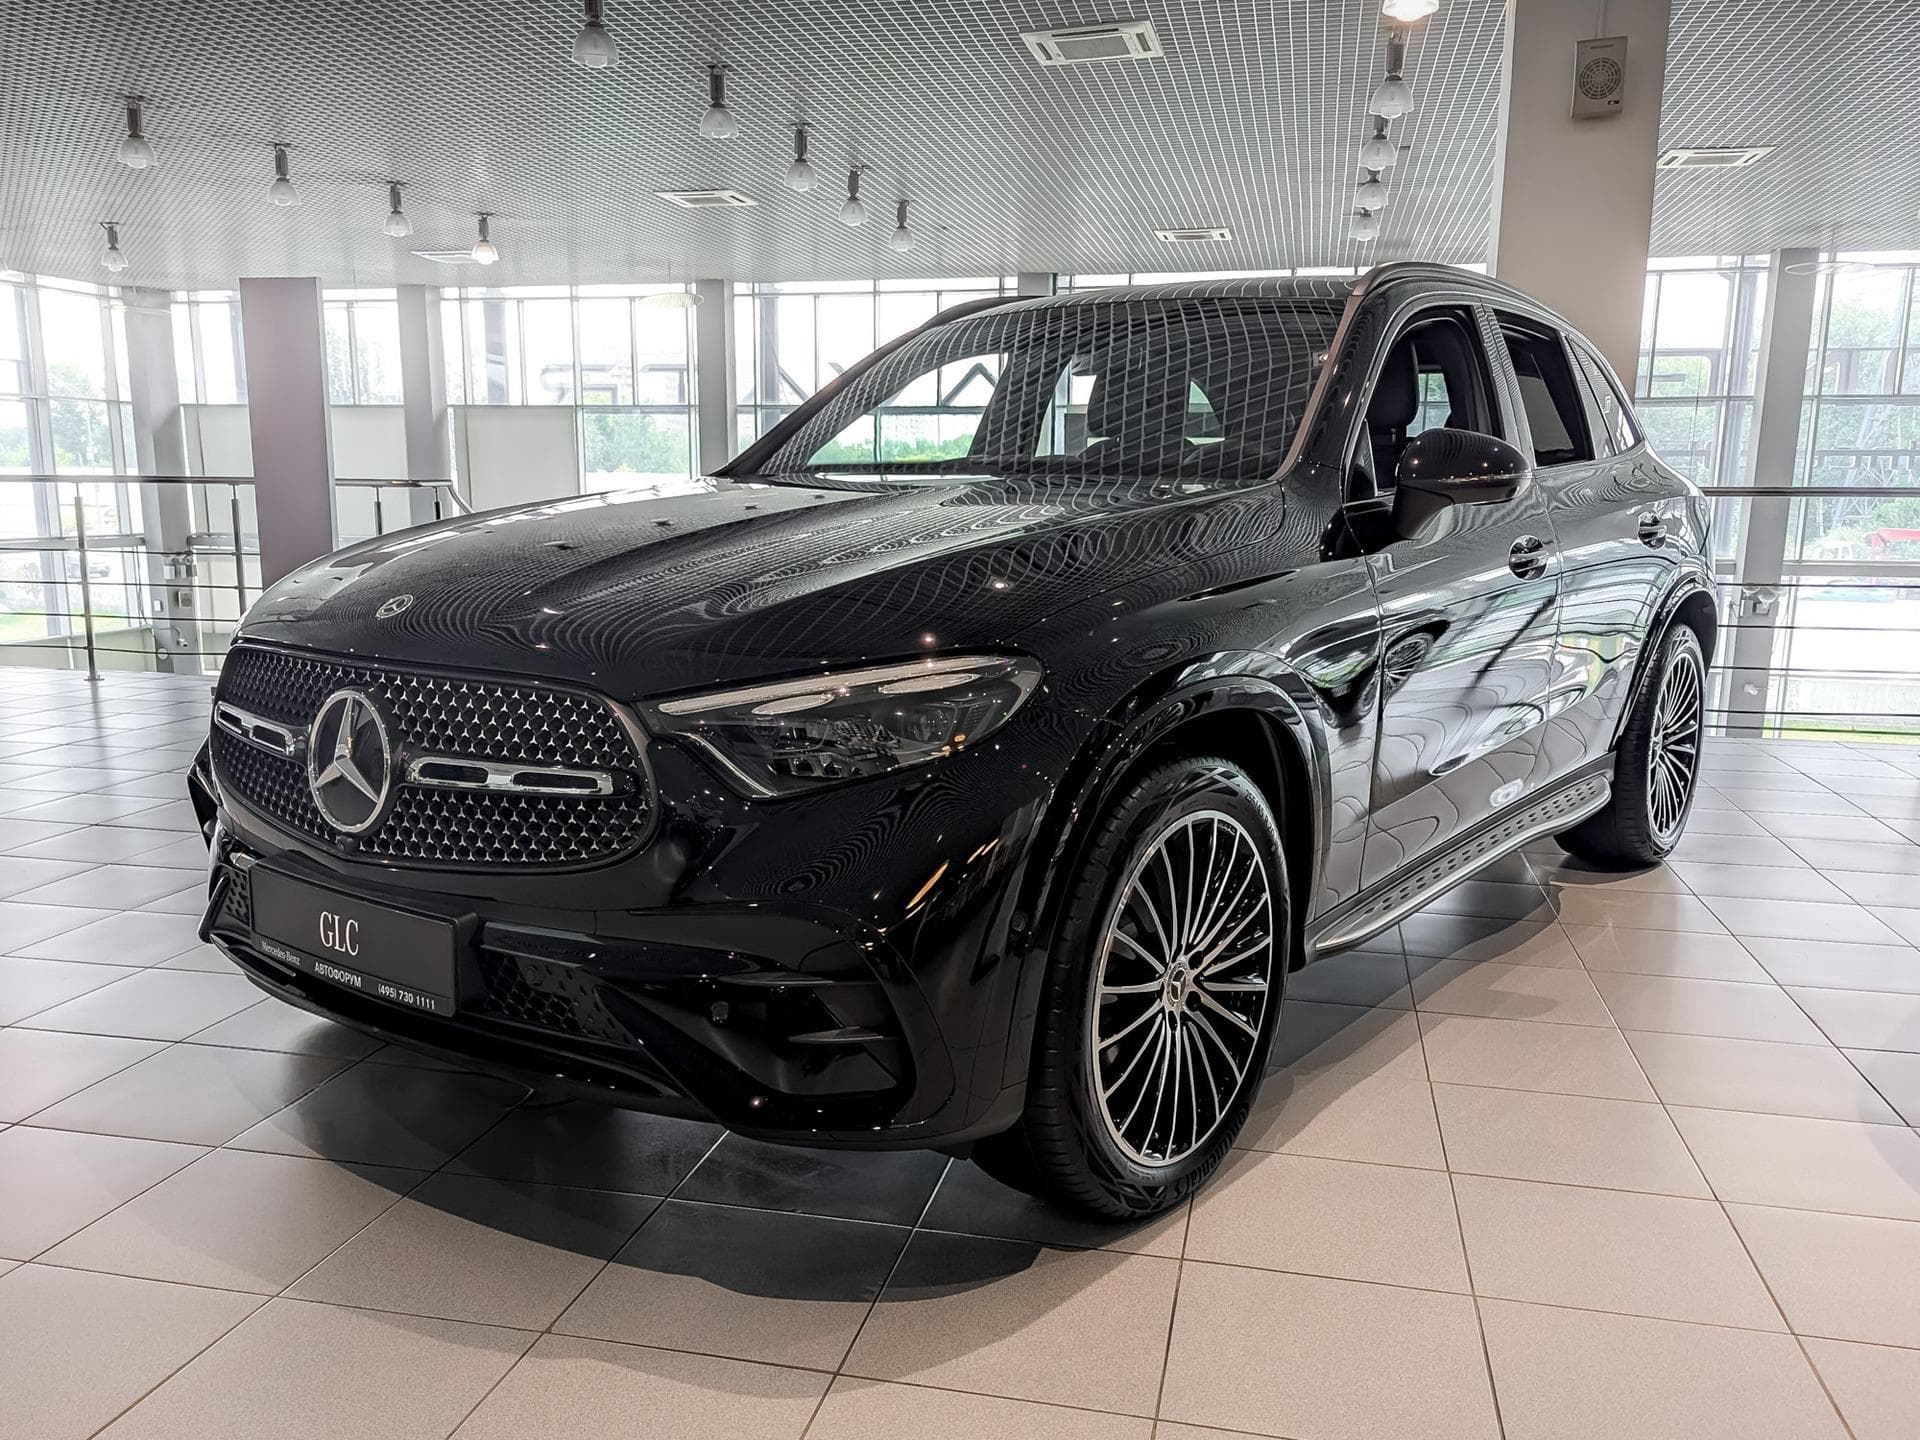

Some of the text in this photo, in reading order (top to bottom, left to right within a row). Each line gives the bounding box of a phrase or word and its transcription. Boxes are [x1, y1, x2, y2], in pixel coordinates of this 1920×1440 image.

[319, 911, 359, 956] GLC
[261, 940, 300, 966] Mercedes-Benz
[314, 961, 362, 988] АВТОФОРУМ
[378, 983, 435, 1010] (495) 730 1111
